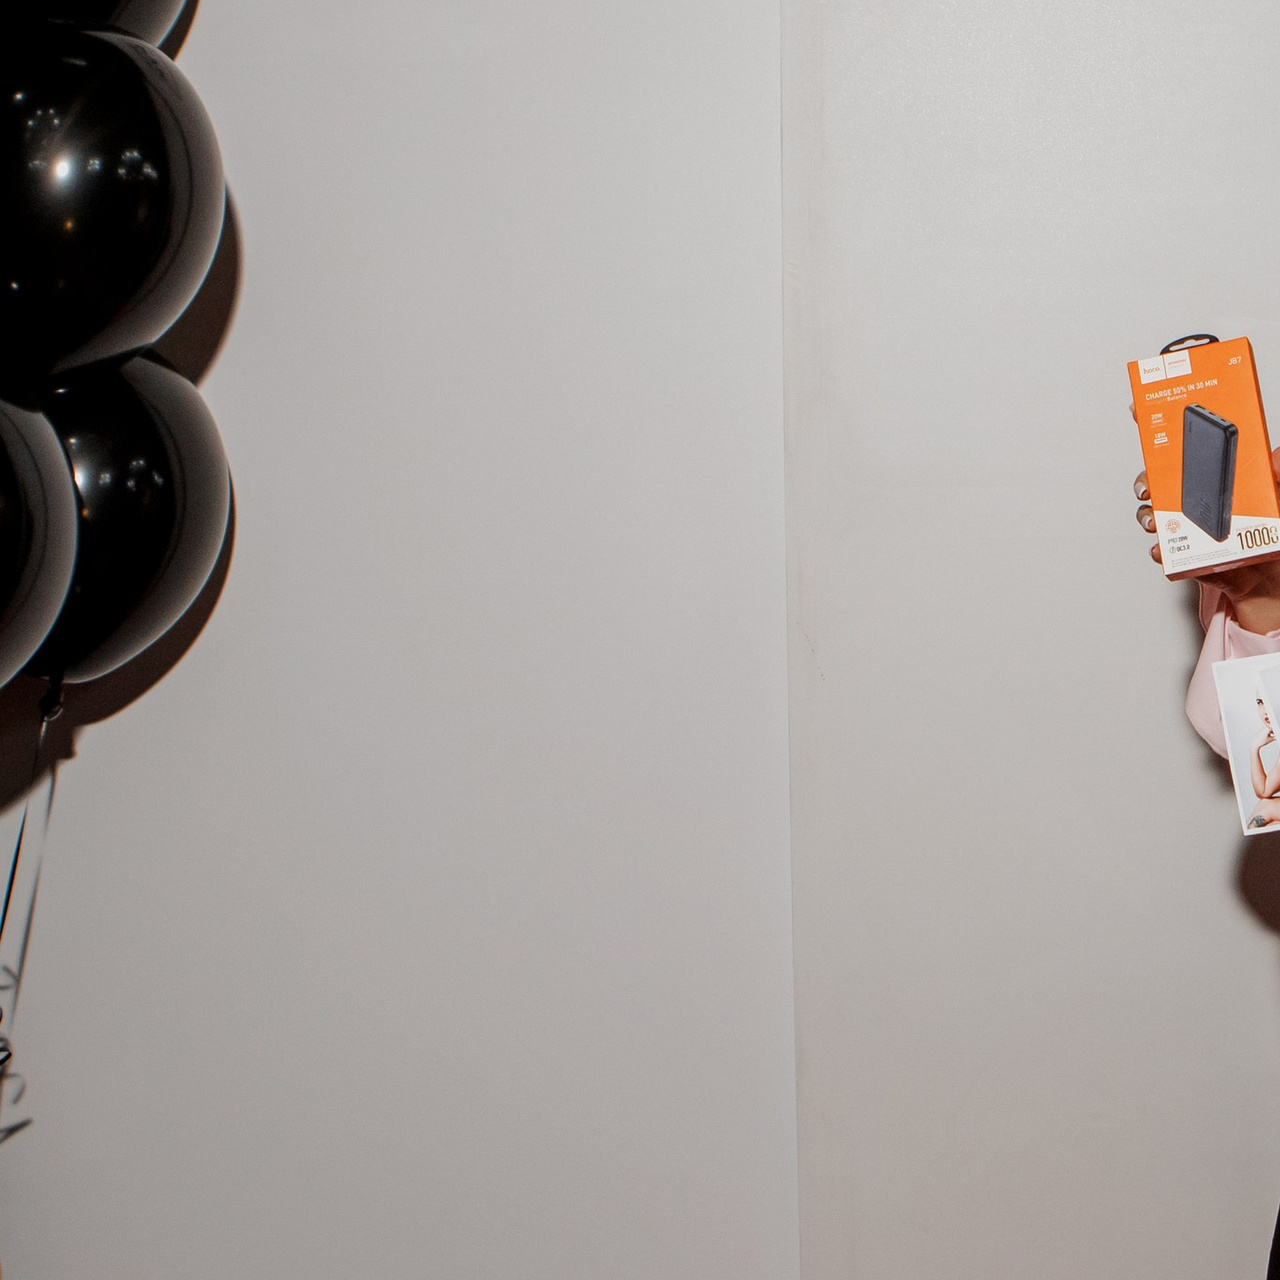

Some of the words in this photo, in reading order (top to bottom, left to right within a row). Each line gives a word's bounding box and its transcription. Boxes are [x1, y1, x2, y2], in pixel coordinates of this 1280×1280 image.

[1228, 356, 1242, 366] J87
[1145, 388, 1172, 401] CHARGE
[1173, 386, 1187, 395] 50%
[1196, 381, 1204, 389] 30
[1205, 379, 1218, 387] MIN
